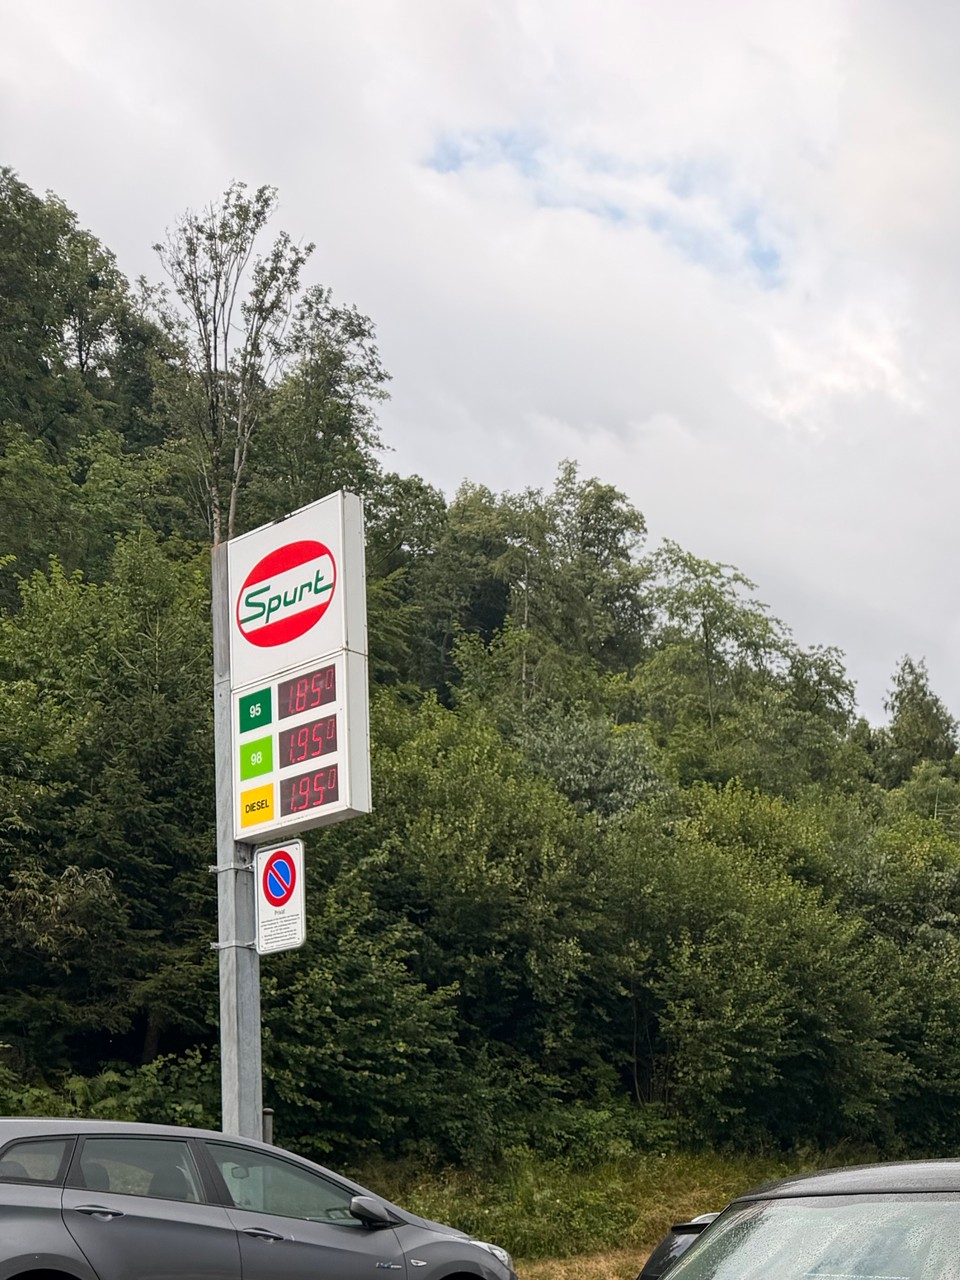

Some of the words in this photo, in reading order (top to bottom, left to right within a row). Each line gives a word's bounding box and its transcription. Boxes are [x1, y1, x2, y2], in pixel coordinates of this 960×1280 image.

[240, 569, 333, 624] Spurt
[249, 703, 262, 718] 95
[250, 752, 263, 766] 98
[245, 801, 270, 814] DIESEL
